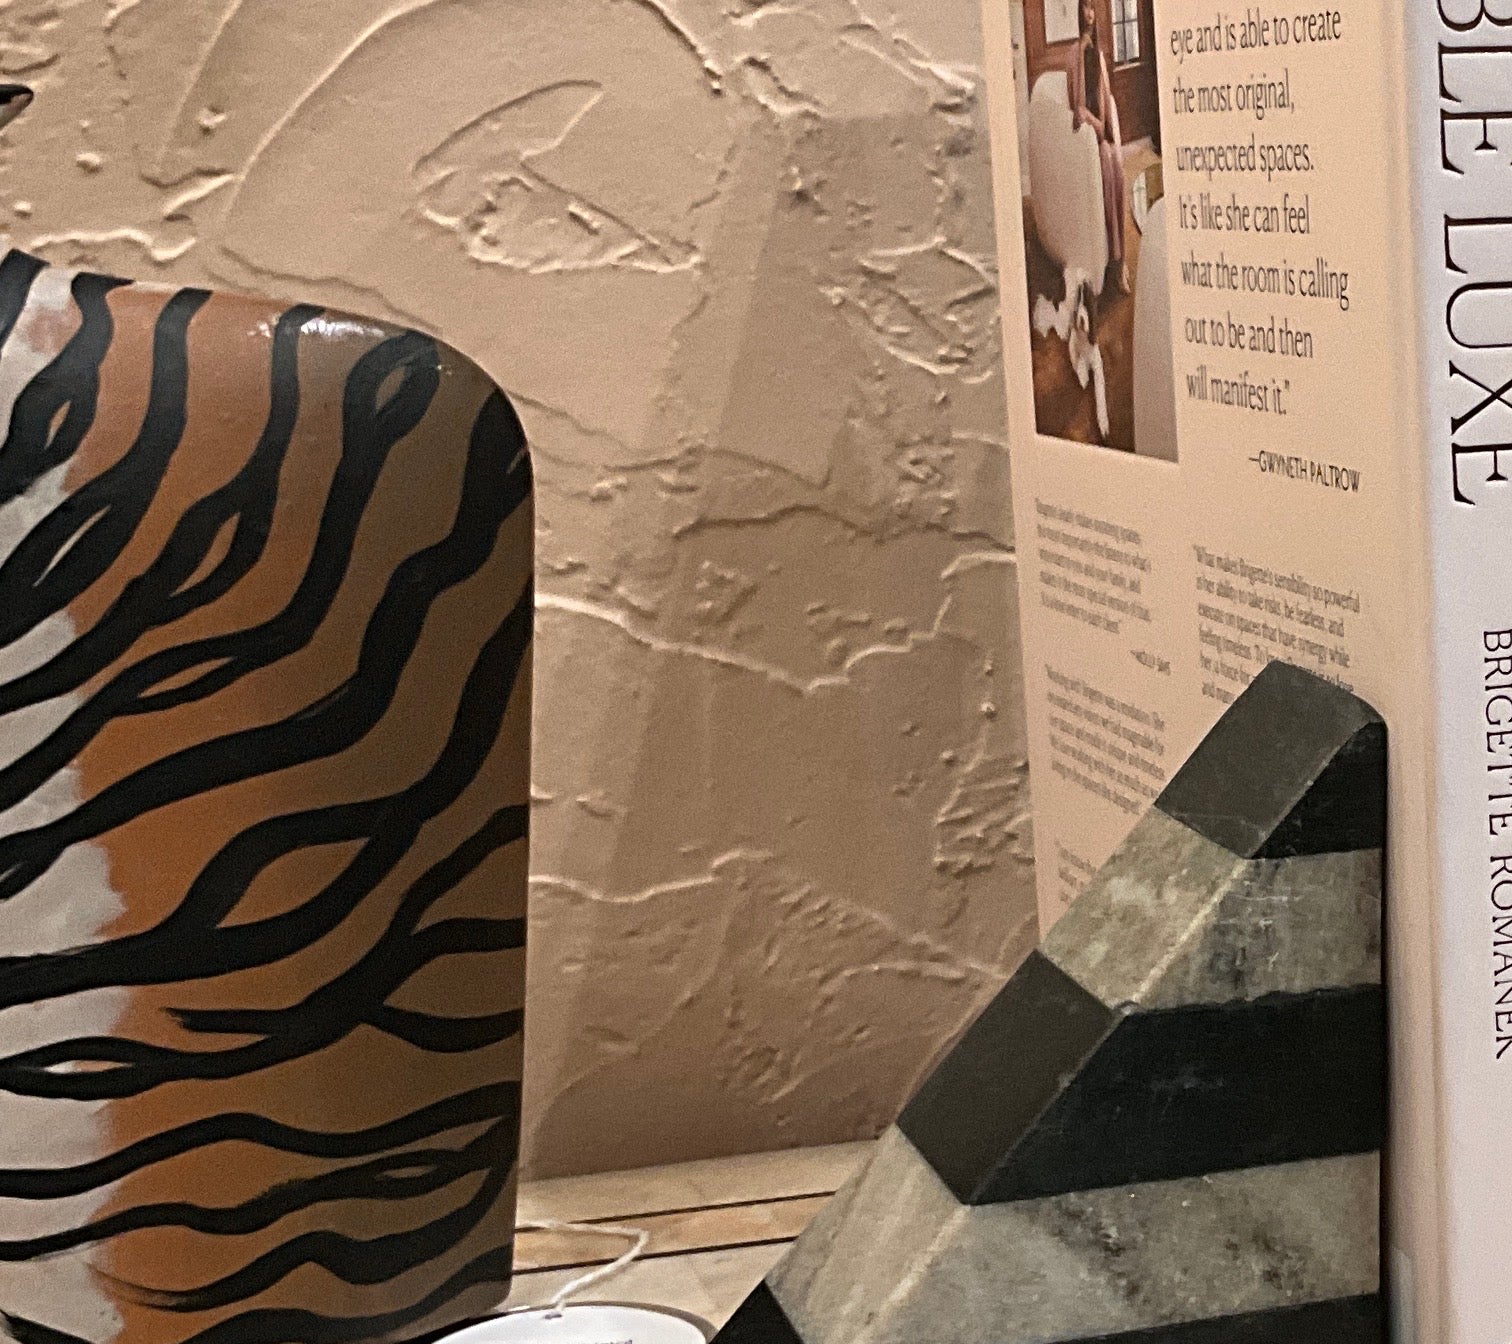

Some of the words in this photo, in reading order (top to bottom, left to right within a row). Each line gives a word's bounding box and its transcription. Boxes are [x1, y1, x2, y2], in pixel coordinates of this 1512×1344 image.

[1170, 26, 1194, 65] eye
[1196, 13, 1222, 54] and
[1224, 15, 1236, 52] is
[1239, 8, 1270, 50] able
[1273, 14, 1290, 46] to
[1292, 9, 1342, 44] create
[1173, 76, 1195, 116] the
[1197, 80, 1232, 114] most
[1235, 68, 1295, 121] original,
[1176, 133, 1256, 181] unexpected
[1259, 142, 1315, 183] spaces.
[1200, 191, 1223, 232] like
[1225, 193, 1251, 234] she
[1253, 203, 1280, 234] can
[1283, 194, 1312, 235] feel
[1181, 249, 1213, 288] what
[1215, 251, 1239, 292] the
[1241, 262, 1280, 296] room
[1283, 259, 1297, 297] is
[1298, 256, 1350, 311] calling
[1185, 314, 1208, 346] out
[1209, 316, 1226, 348] to
[1227, 310, 1247, 351] be
[1248, 315, 1276, 355] and
[1278, 317, 1314, 359] then
[1186, 364, 1208, 402] will
[1210, 368, 1269, 413] manifest
[1310, 459, 1361, 494] PALTROW
